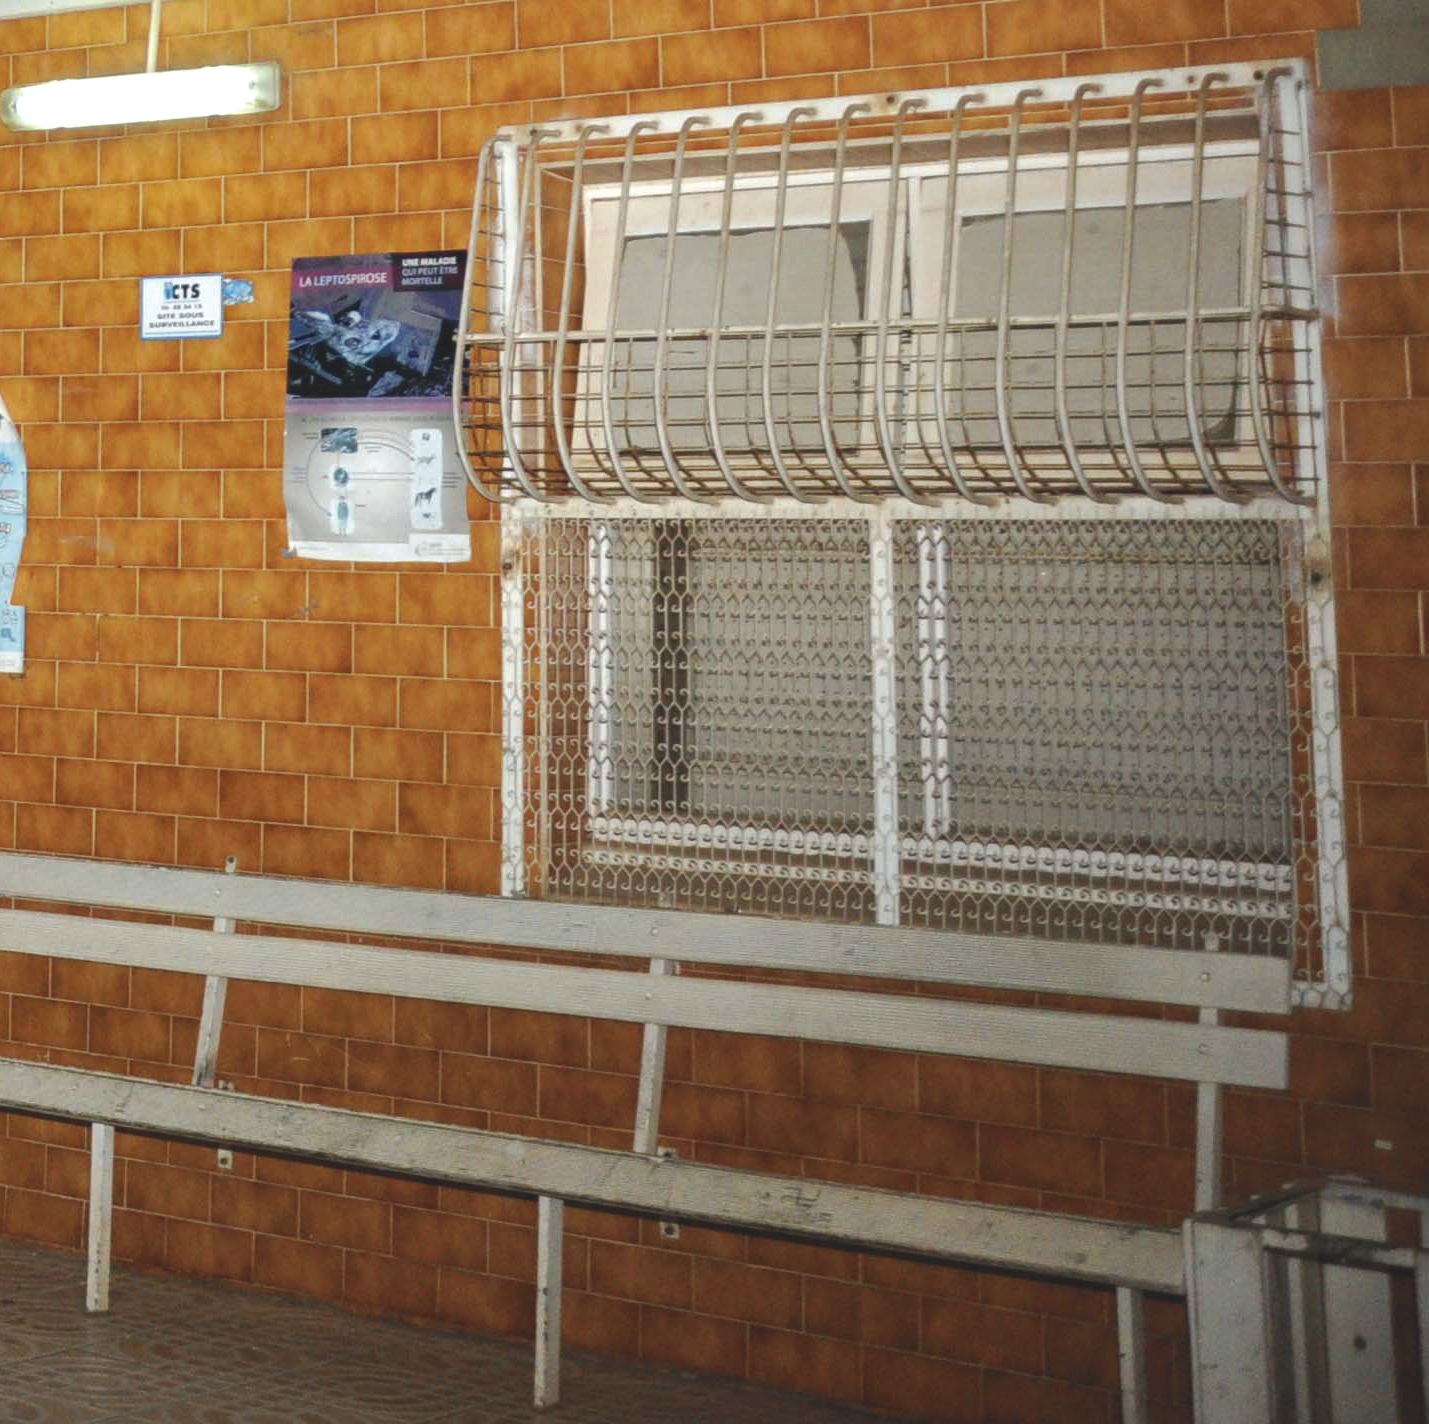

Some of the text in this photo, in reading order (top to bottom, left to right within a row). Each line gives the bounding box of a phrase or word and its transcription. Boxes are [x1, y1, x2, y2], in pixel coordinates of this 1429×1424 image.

[420, 256, 457, 266] MALADIE
[401, 268, 416, 277] QUI
[418, 266, 438, 276] PEUT
[299, 272, 388, 287] LA LEPTOSPIROSE
[401, 277, 443, 286] MORTELLE
[148, 320, 215, 329] SURVEILLANCE
